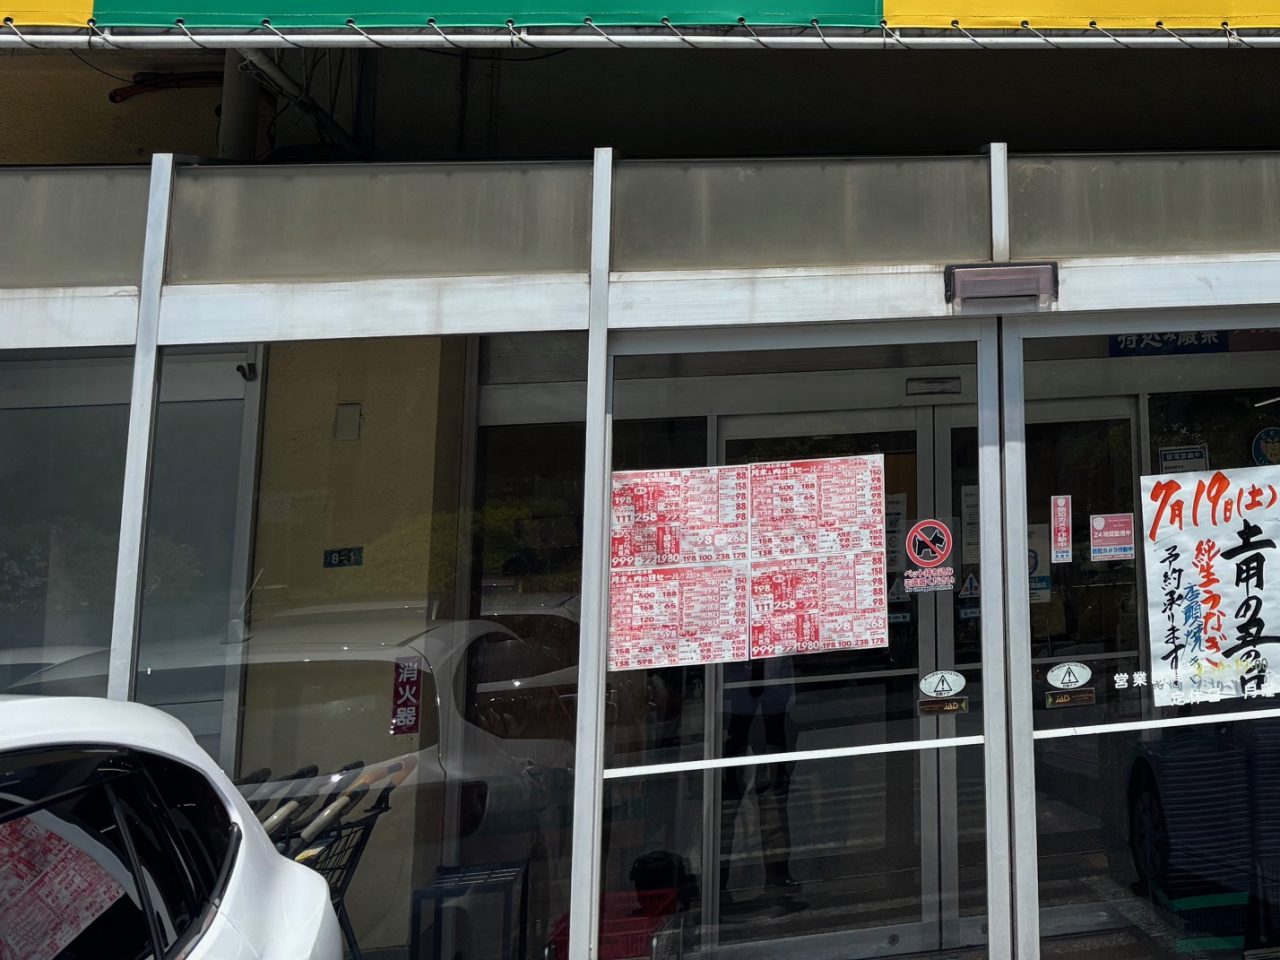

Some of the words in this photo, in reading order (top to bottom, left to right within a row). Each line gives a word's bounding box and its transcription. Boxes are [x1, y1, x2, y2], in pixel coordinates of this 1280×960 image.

[1149, 470, 1278, 542] 7月19日(土)
[397, 662, 418, 726] 消火器
